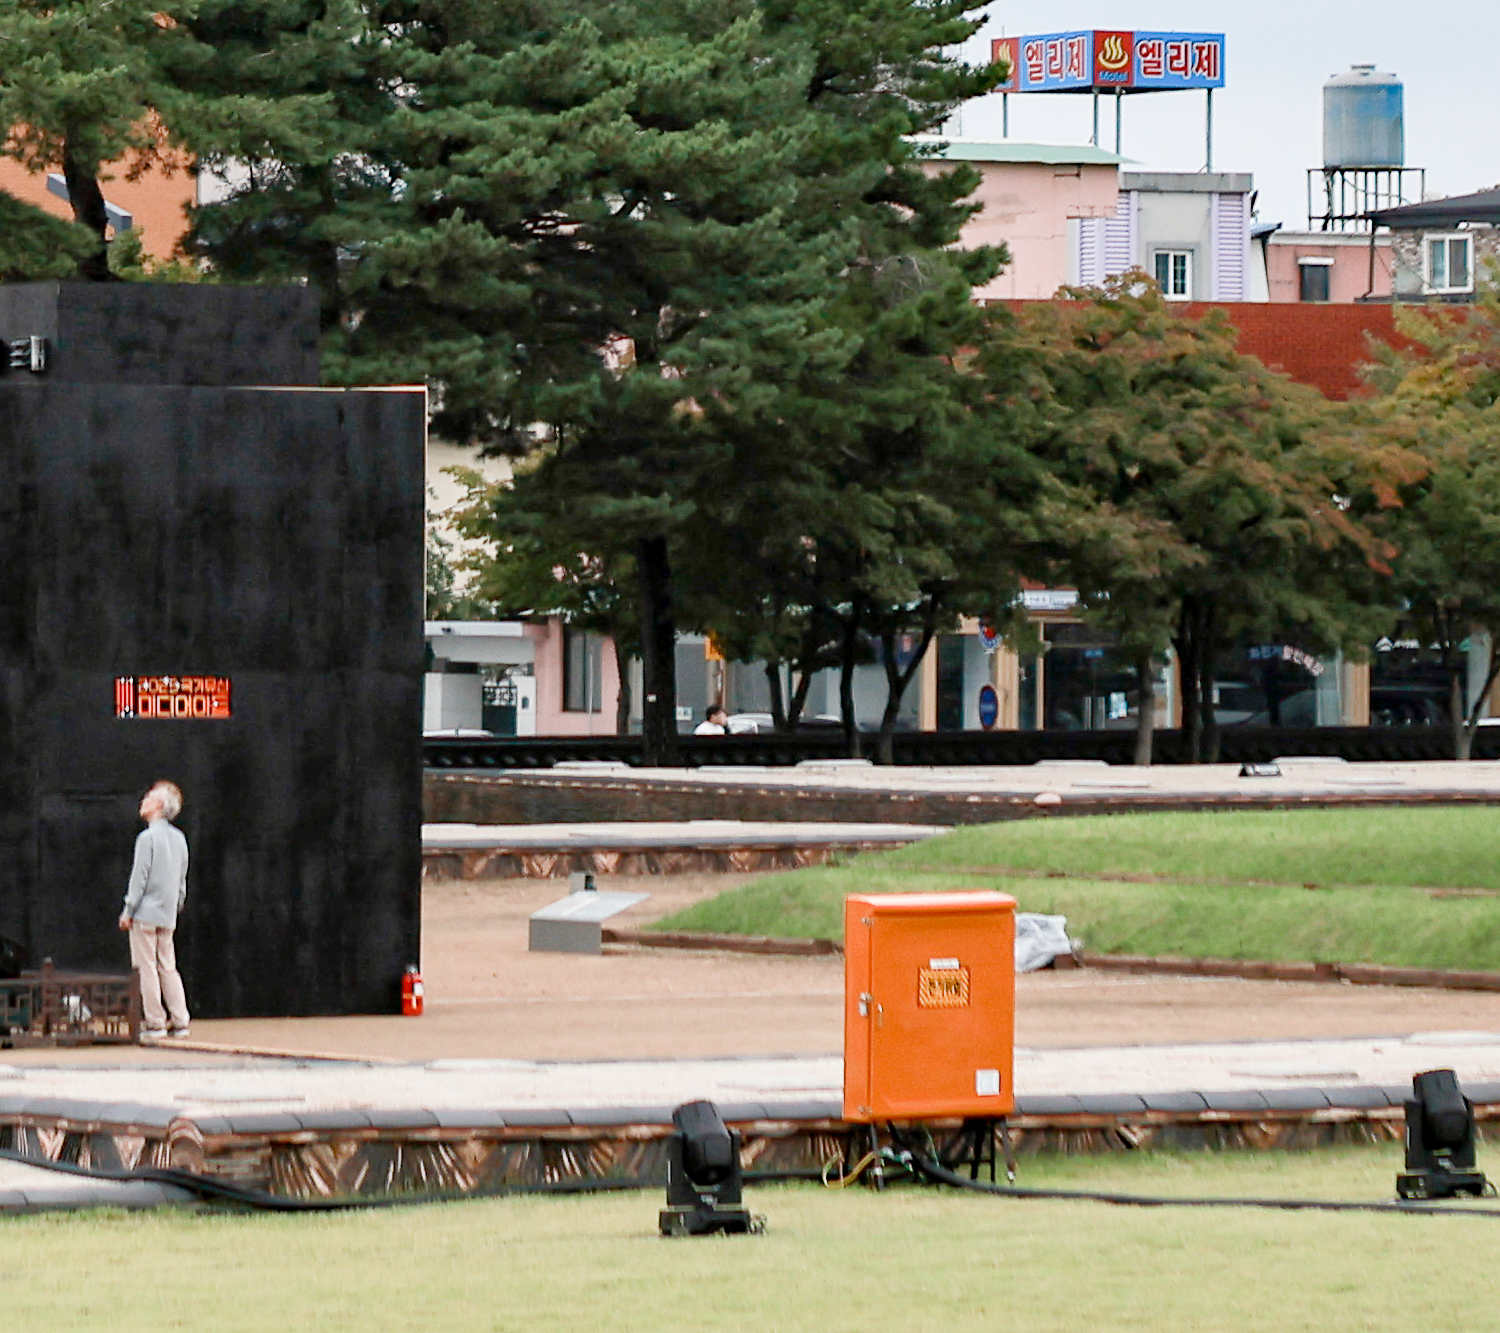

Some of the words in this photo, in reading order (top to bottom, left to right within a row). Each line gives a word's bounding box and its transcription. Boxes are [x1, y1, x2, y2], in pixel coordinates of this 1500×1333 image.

[1023, 35, 1088, 84] 엘리제
[1135, 38, 1222, 81] 엘리제
[138, 694, 229, 718] 미디어아트
